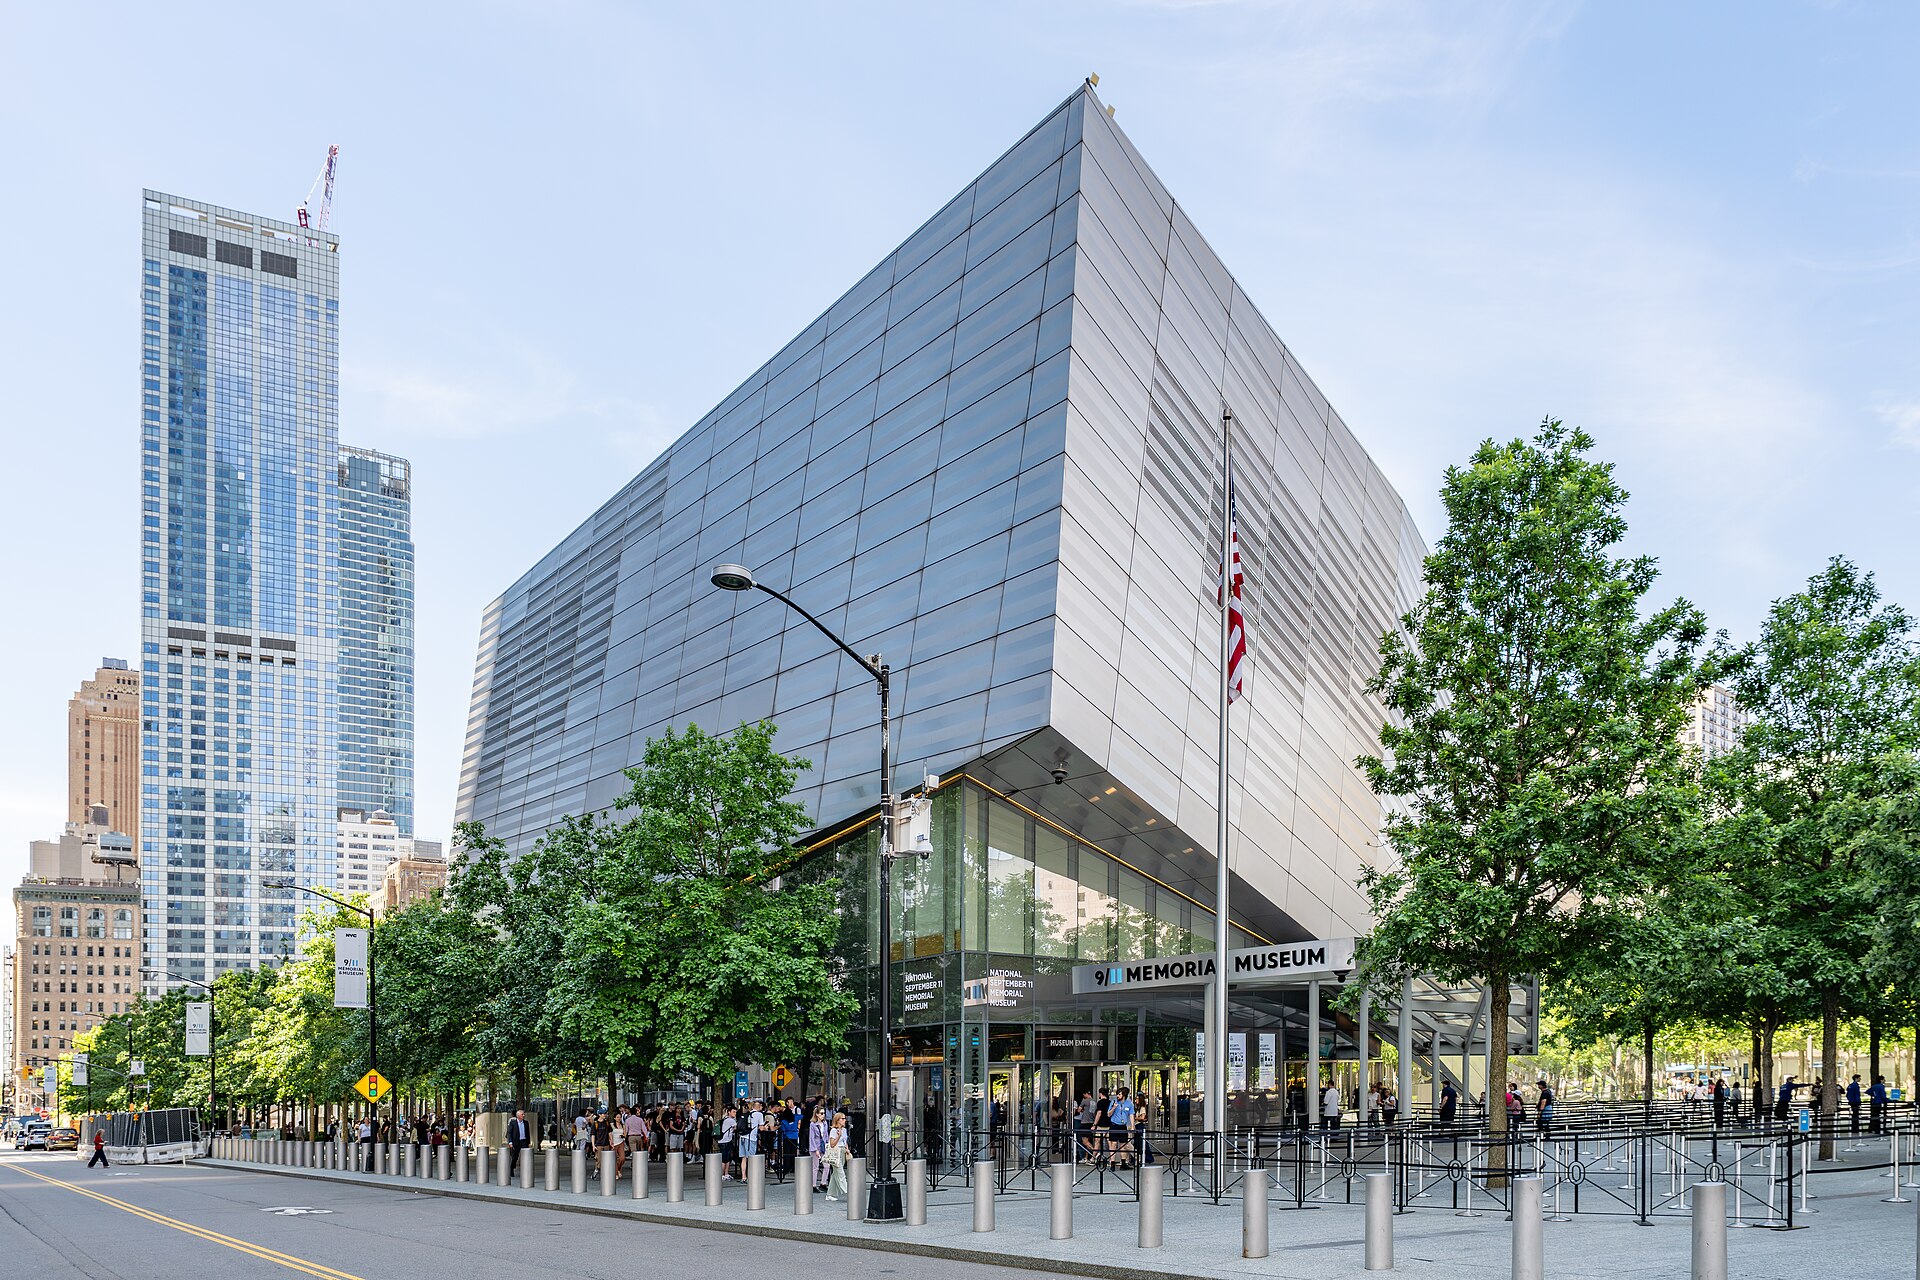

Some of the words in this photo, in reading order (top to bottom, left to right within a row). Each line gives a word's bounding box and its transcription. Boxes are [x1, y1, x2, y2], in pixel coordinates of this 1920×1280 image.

[344, 959, 358, 967] 9/11
[1094, 967, 1123, 986] 9/11
[1126, 959, 1217, 982] MEMORIA
[1235, 947, 1325, 972] MUSEUM
[905, 972, 933, 982] NATIONAL
[990, 969, 1022, 978] NATIONAL
[905, 981, 937, 992] SEPTEMBER
[938, 980, 943, 988] 11
[990, 979, 1027, 988] SEPTEMBER
[905, 992, 934, 1002] MEMORIAL
[990, 990, 1024, 998] MEMORIAL
[905, 1002, 928, 1011] MUSEUM
[949, 1028, 957, 1046] 9/11
[972, 1027, 980, 1046] 9/11
[949, 1049, 957, 1113] MEMORIAL
